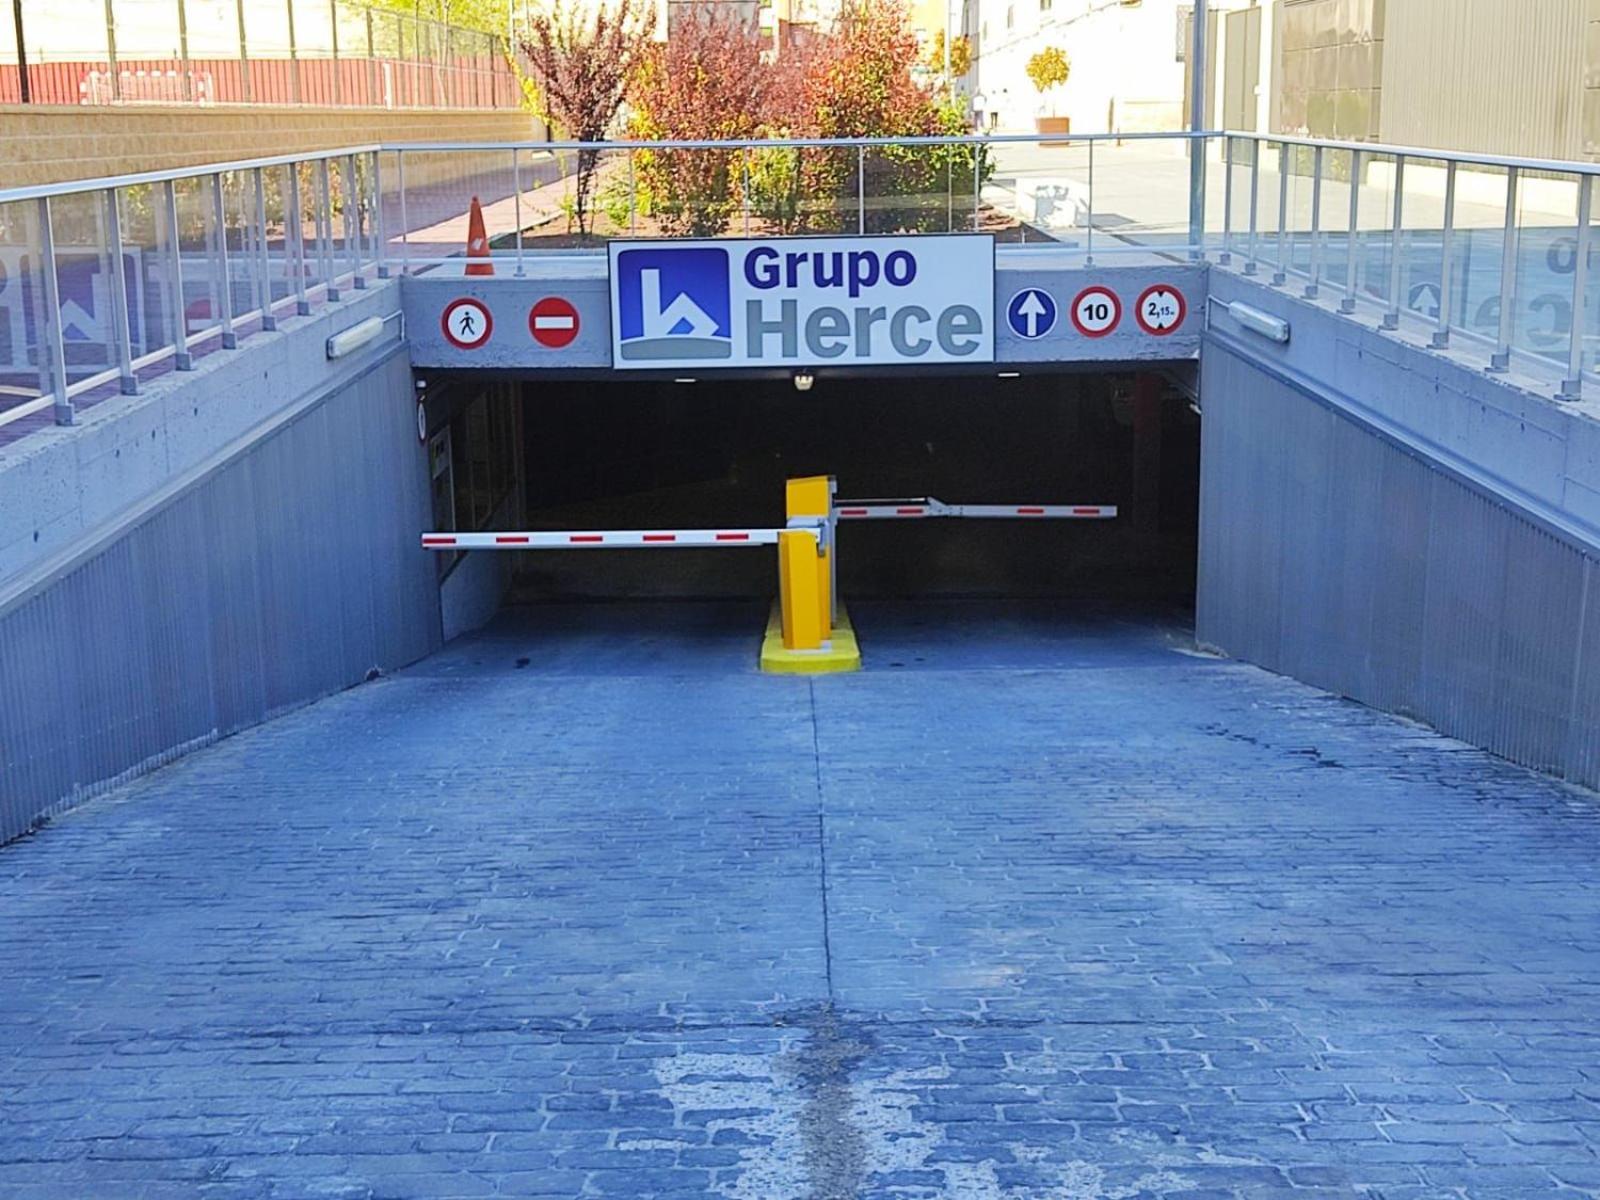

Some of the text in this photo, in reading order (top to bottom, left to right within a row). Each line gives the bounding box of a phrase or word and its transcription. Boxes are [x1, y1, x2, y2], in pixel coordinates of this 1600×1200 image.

[744, 246, 917, 298] Grupo
[746, 299, 983, 358] Herce
[1083, 303, 1108, 321] 10
